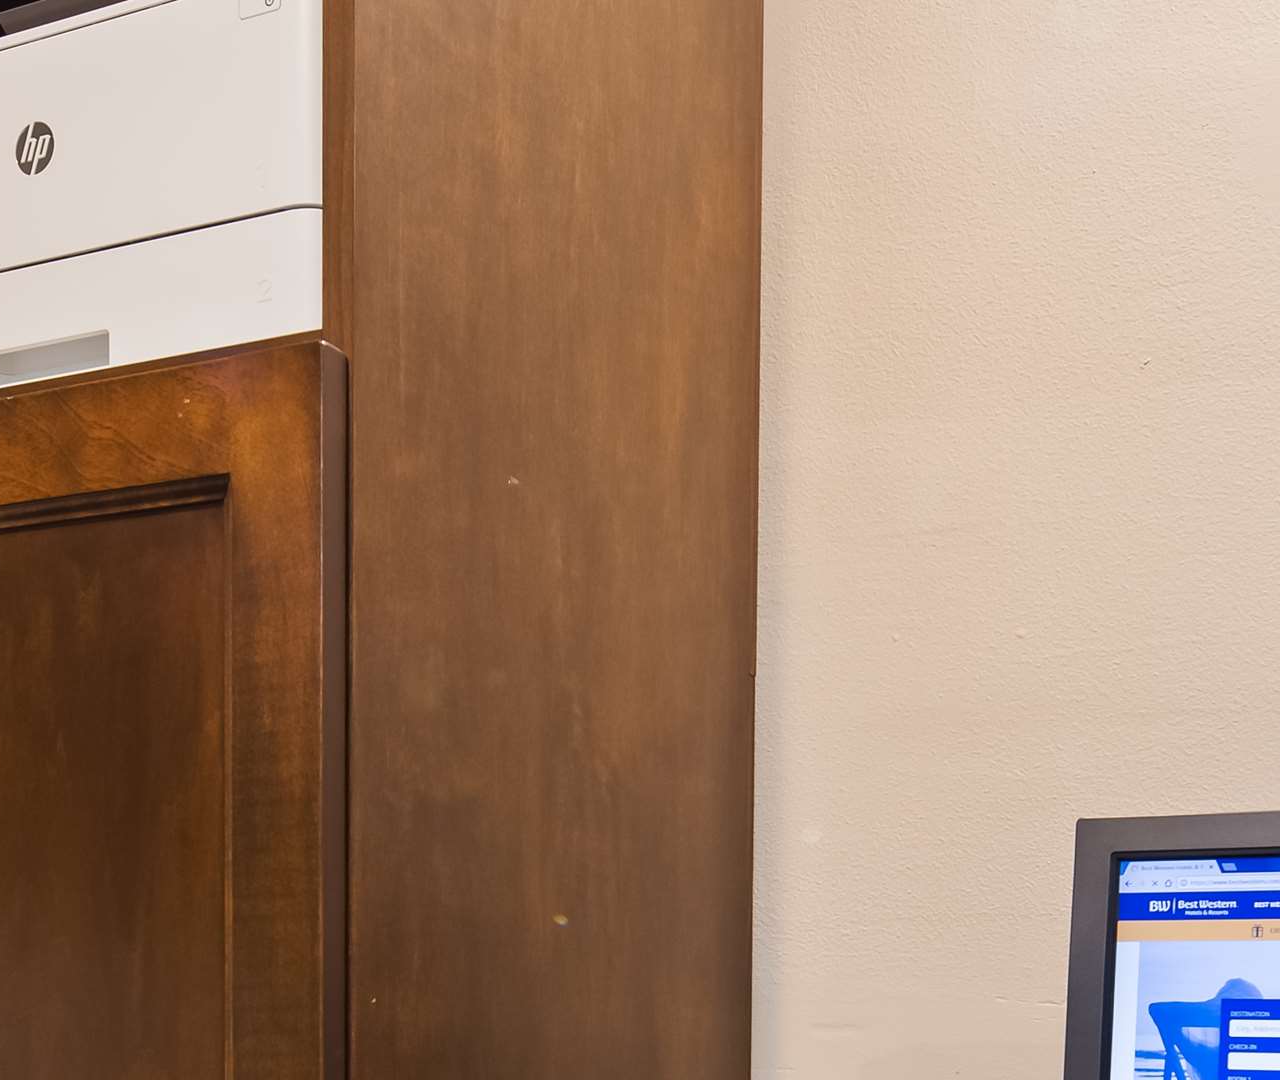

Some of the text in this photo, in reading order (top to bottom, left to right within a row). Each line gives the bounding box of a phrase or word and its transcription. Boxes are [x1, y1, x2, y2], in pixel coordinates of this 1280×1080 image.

[17, 121, 54, 175] hp
[1149, 899, 1237, 912] BW Best Western
